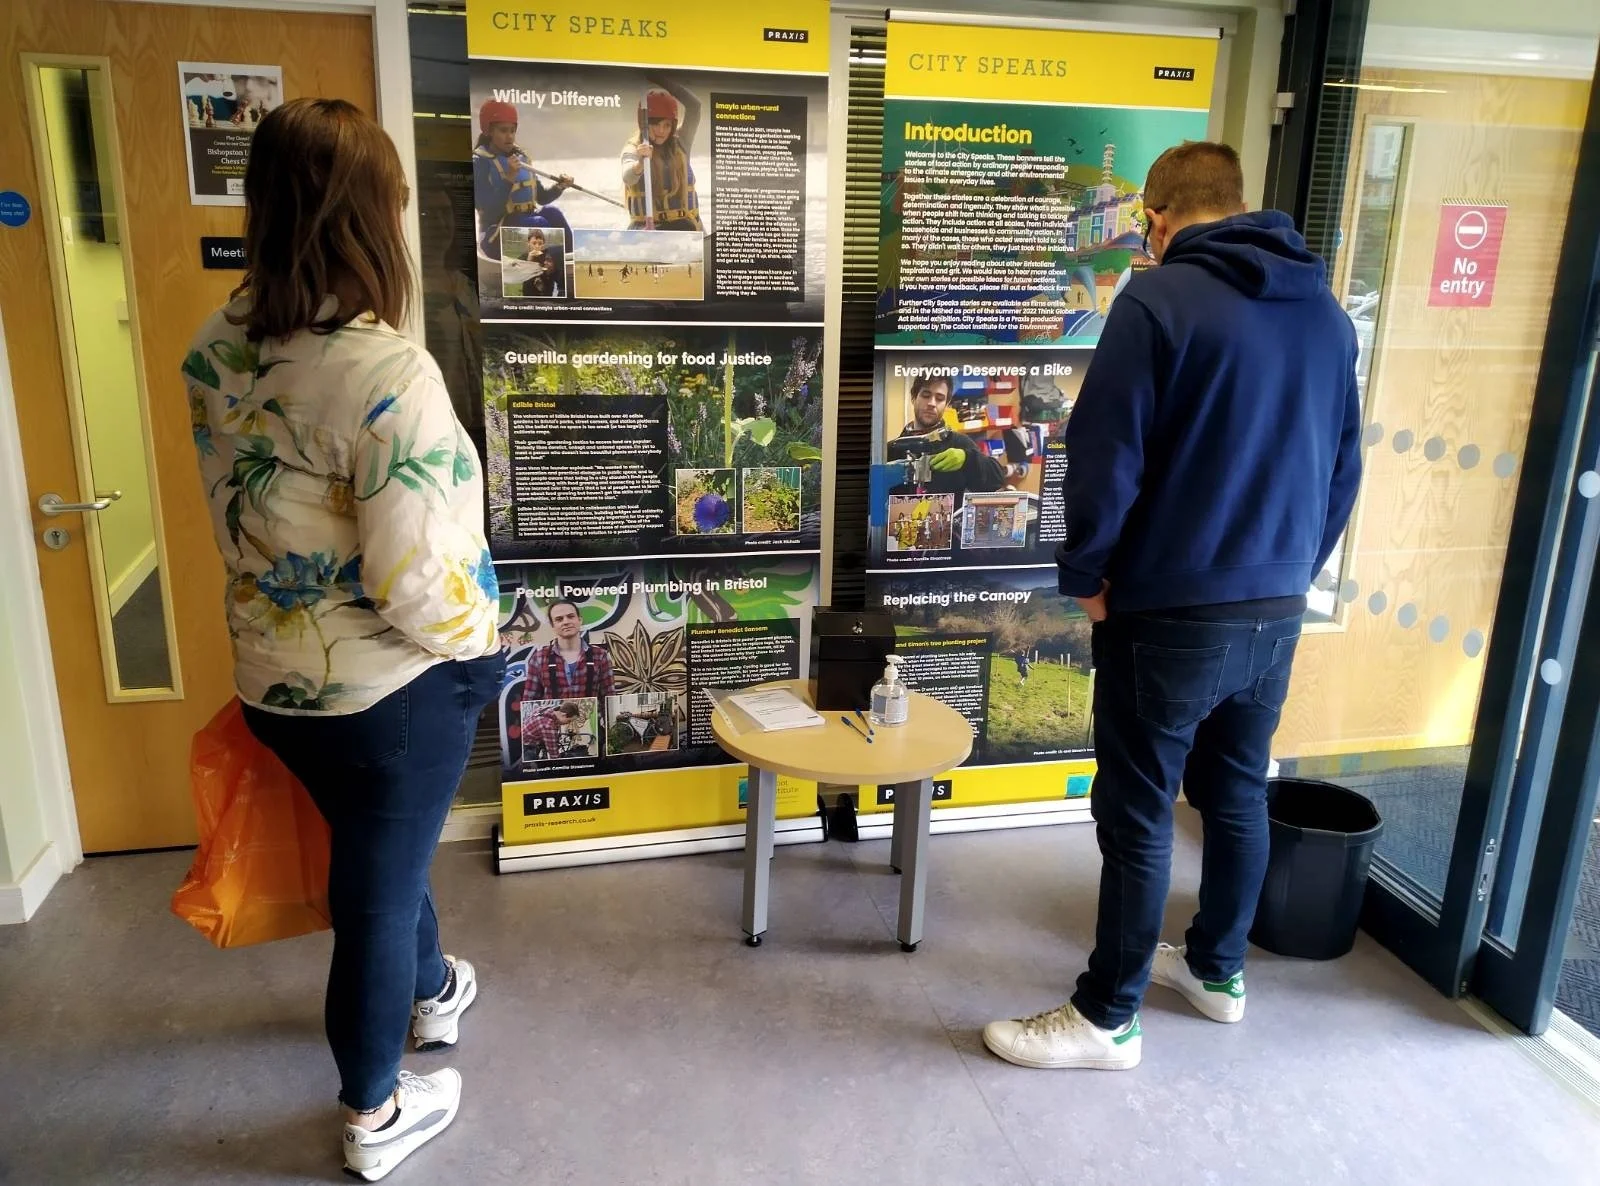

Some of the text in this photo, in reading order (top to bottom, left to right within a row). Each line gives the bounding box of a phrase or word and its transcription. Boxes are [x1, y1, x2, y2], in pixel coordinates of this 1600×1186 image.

[493, 12, 668, 38] CITY SPEAKS
[768, 31, 805, 40] PRAXIS
[909, 54, 1067, 78] CITY SPEAKS
[1158, 70, 1191, 78] PRAXIS
[493, 89, 620, 109] Wildly Different
[905, 122, 1032, 144] Introduction
[905, 150, 936, 158] Welcome
[956, 152, 969, 162] City
[970, 152, 995, 162] Speaks.
[972, 160, 981, 170] by
[982, 161, 1009, 171] ordinary
[1010, 161, 1032, 171] people
[1033, 162, 1068, 172] responding
[949, 177, 978, 187] everyday
[950, 170, 985, 179] emergency
[1018, 170, 1064, 179] environmental
[1454, 257, 1478, 275] No
[1440, 276, 1486, 298] entry
[962, 307, 975, 316] part
[898, 322, 929, 332] supported
[930, 322, 938, 332] by
[504, 351, 771, 368] Guerilla gardening for food Justice
[894, 363, 1072, 380] Everyone Deserves a Bike
[516, 578, 767, 600] Pedal Powered Plumbing in Bristol
[883, 591, 1031, 608] Replacing the Canopy
[533, 794, 601, 809] PRAXIS
[524, 817, 596, 829] praxis-research.co.uk
